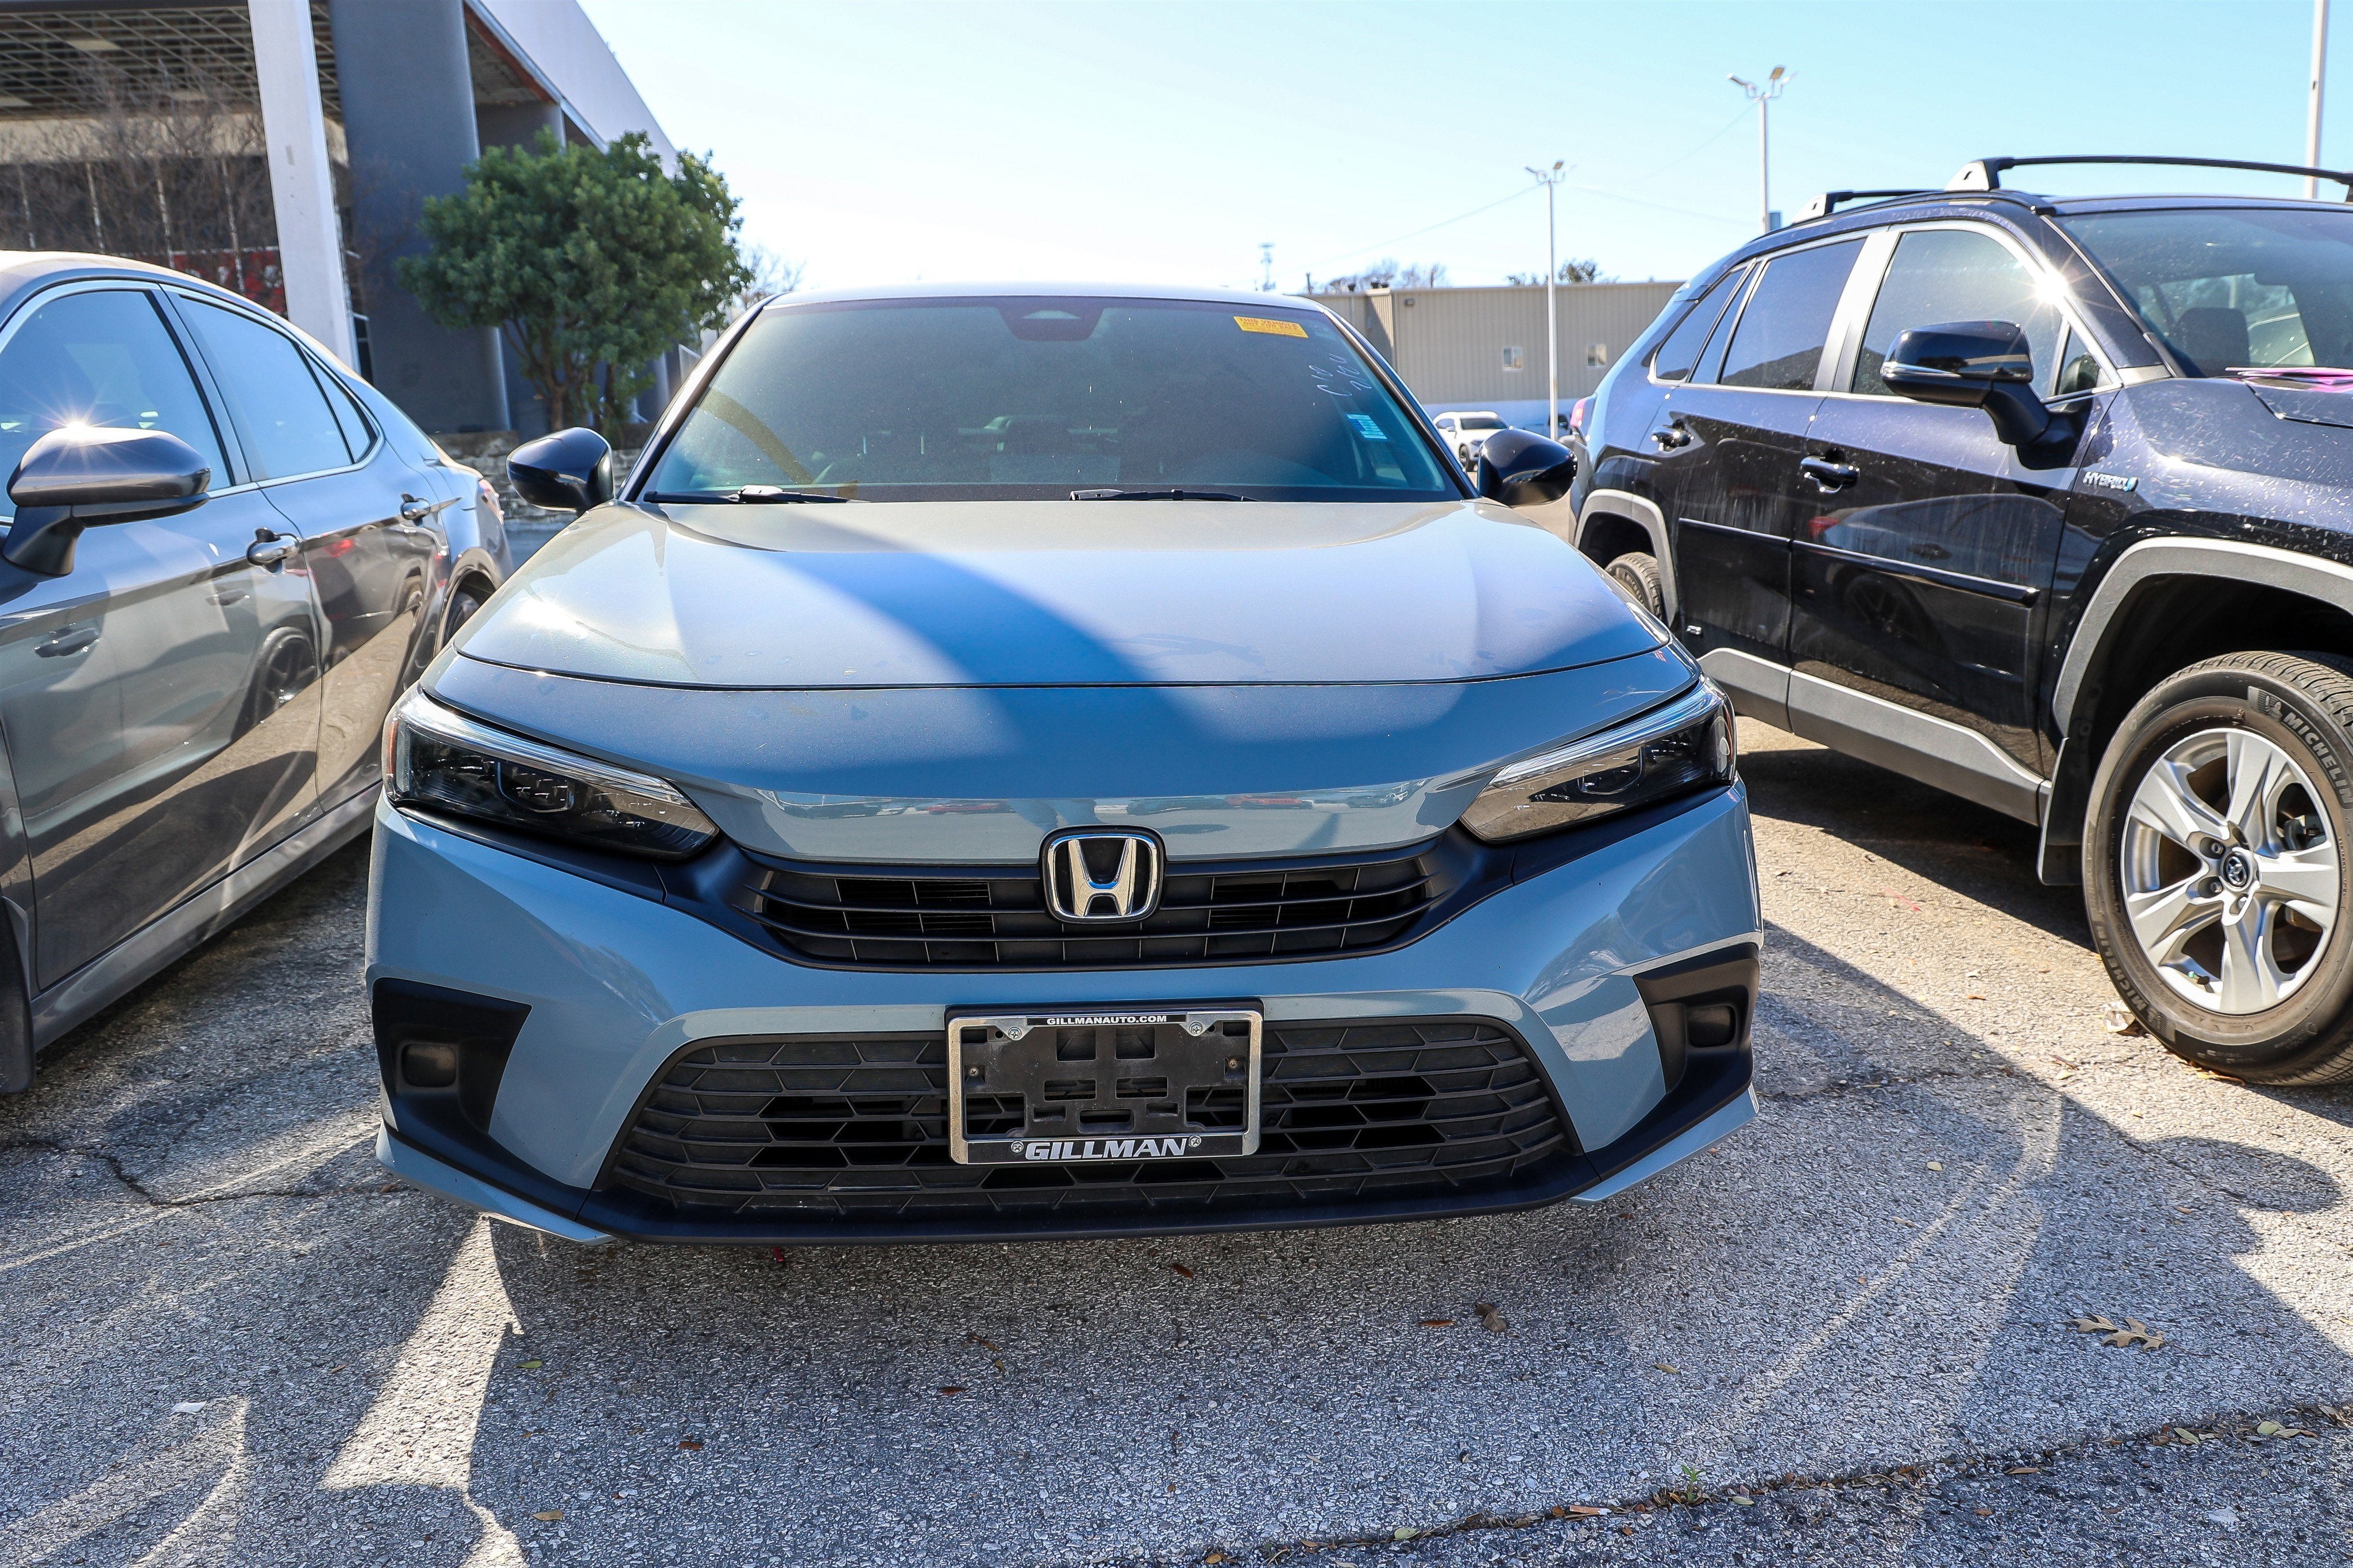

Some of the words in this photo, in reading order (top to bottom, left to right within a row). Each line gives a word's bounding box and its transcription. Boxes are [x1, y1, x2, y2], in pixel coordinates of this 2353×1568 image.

[2082, 471, 2129, 490] HYBRID
[2283, 712, 2353, 804] MICHELIN
[2096, 925, 2148, 1011] MICHELIN
[1047, 1015, 1167, 1025] GILLMANAUTO.COM
[1025, 1138, 1187, 1160] GILLMAN
